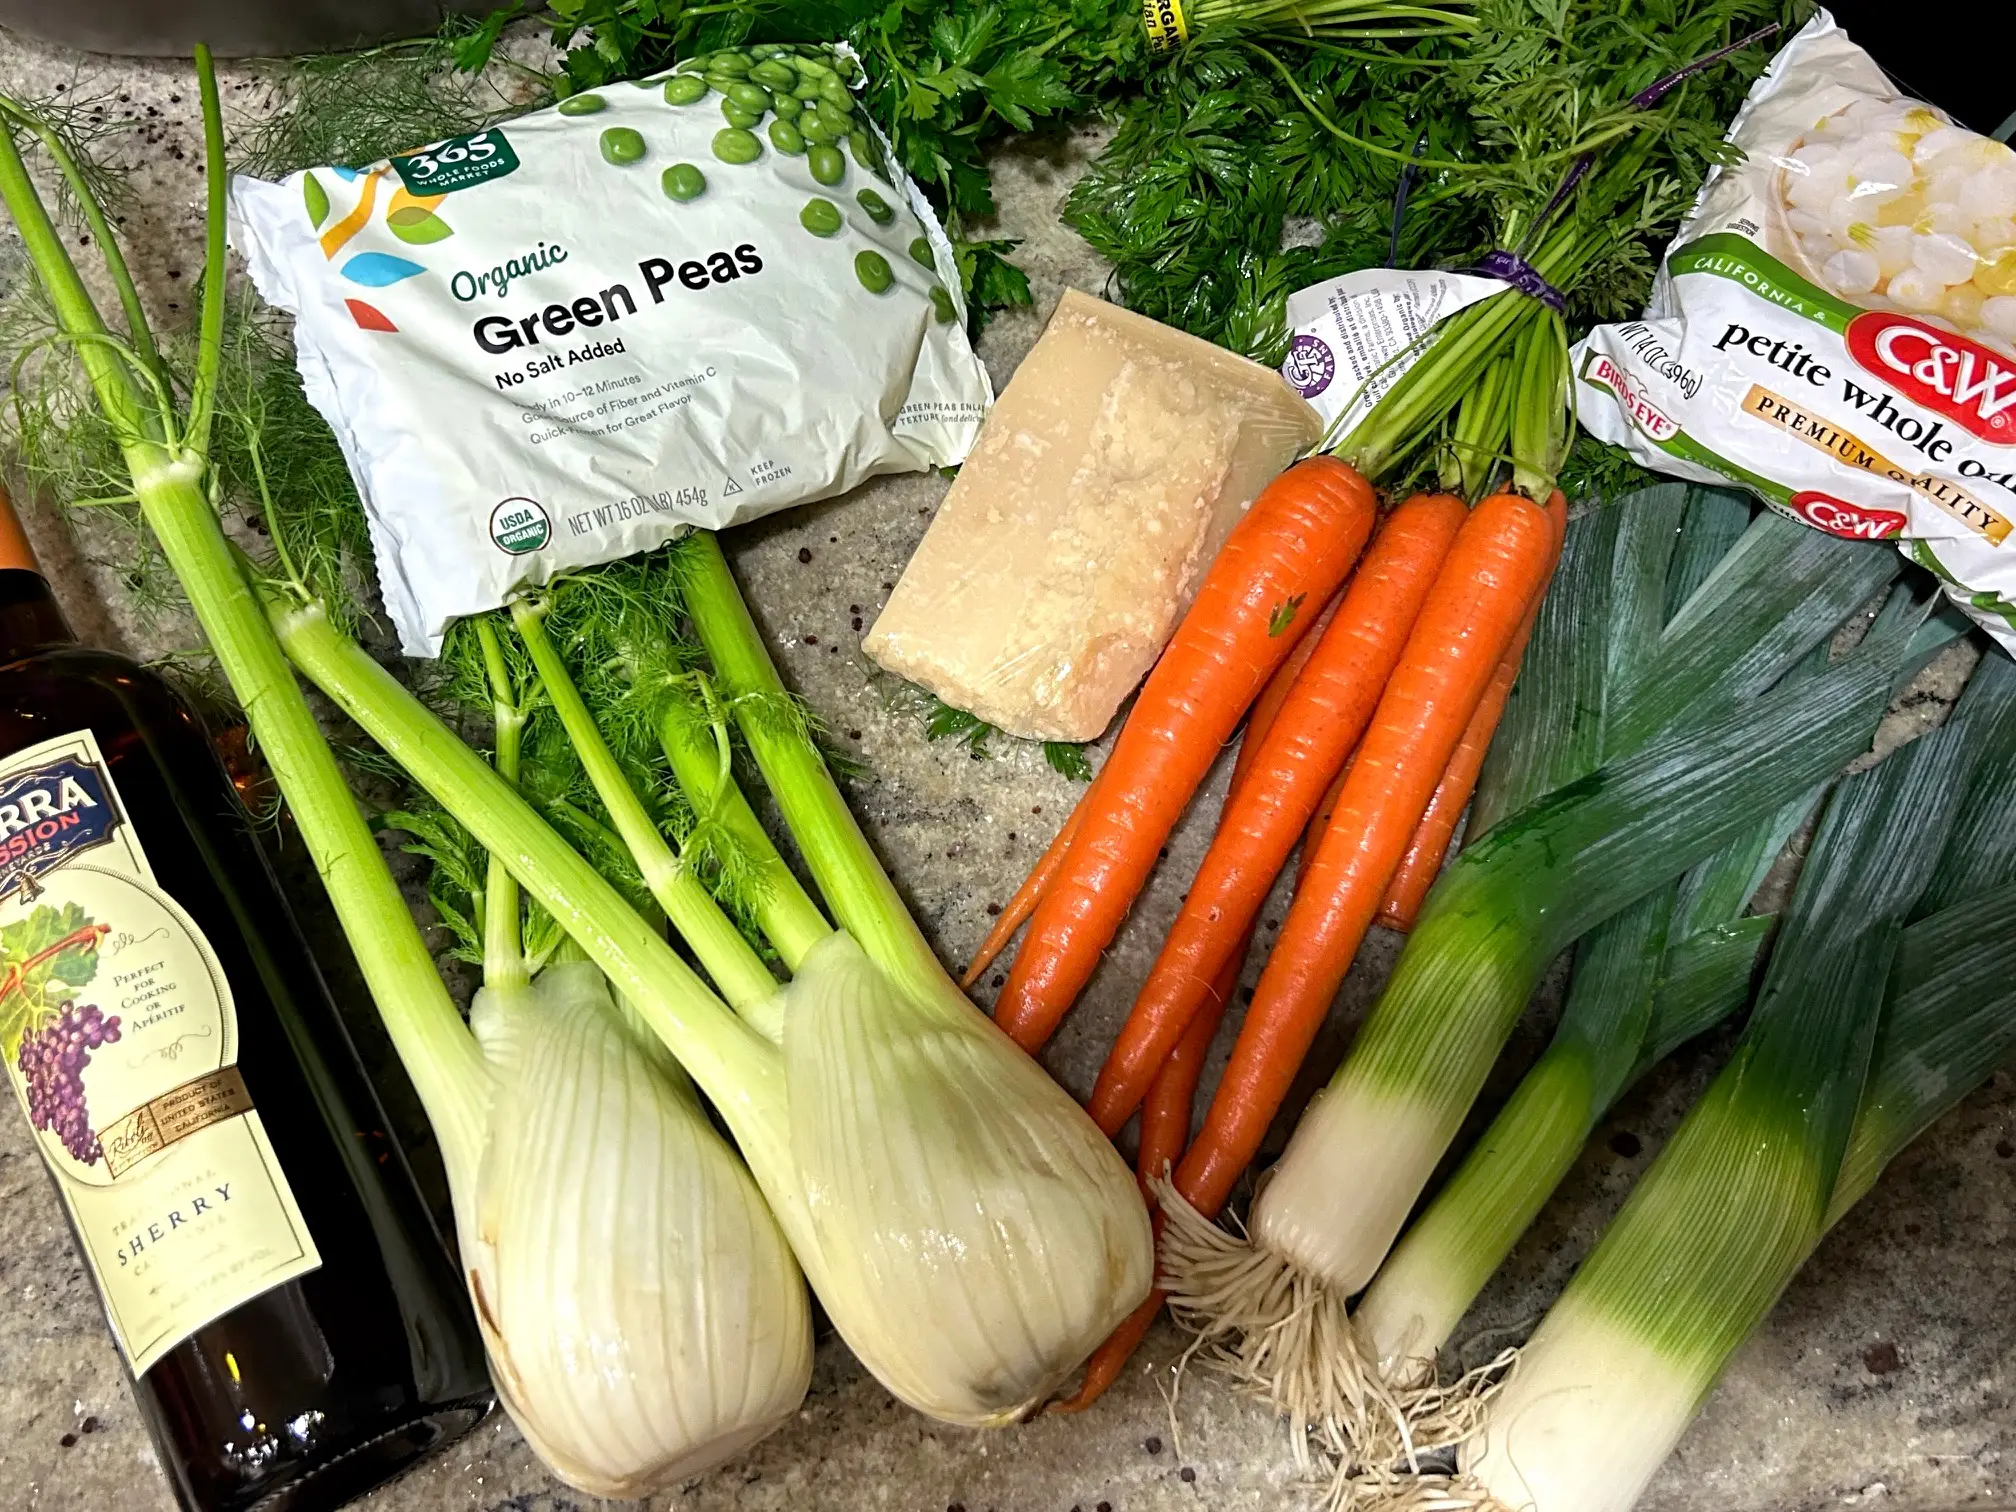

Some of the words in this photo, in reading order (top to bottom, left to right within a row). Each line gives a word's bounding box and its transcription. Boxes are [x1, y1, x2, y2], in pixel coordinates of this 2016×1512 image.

[408, 133, 496, 178] 365
[417, 168, 460, 186] WHOLE
[464, 158, 505, 172] FOODS
[440, 170, 490, 187] MARKET
[451, 241, 569, 302] Organic
[1694, 257, 1803, 313] CALIFORNIA
[1813, 311, 1828, 322] &
[473, 284, 638, 354] Green
[638, 243, 764, 305] Peas
[495, 371, 524, 391] No
[526, 353, 565, 379] Salt
[568, 337, 627, 366] Added
[1311, 339, 1334, 380] FARMS
[1343, 340, 1355, 355] and
[1348, 355, 1365, 381] packed
[1596, 359, 1636, 409] BIRDS
[1875, 326, 2016, 420] C&W
[549, 398, 561, 409] in
[595, 374, 642, 393] Minutes
[597, 403, 608, 415] of
[609, 395, 639, 412] Fiber
[641, 388, 662, 402] and
[662, 373, 706, 393] Vitamin
[703, 366, 717, 378] C
[899, 402, 931, 415] GREEN
[933, 402, 957, 412] PEAS
[1712, 323, 1832, 387] petite
[1842, 378, 1953, 463] whole
[606, 421, 623, 434] for
[624, 409, 657, 427] Great
[659, 393, 692, 414] Flavor
[1756, 396, 1876, 470] PREMIUM
[750, 460, 774, 475] KEEP
[755, 466, 792, 486] FROZEN
[499, 509, 534, 531] USDA
[568, 514, 593, 537] NET
[595, 506, 614, 529] WT
[618, 502, 632, 522] 16
[632, 498, 649, 517] OZ
[675, 486, 708, 507] 454g
[1805, 501, 1890, 539] C&W
[502, 523, 545, 546] ORGANIC
[113, 961, 165, 987] PERFECT
[133, 977, 155, 992] FOR
[121, 982, 177, 1010] COOKING
[145, 1001, 162, 1013] OR
[160, 1104, 196, 1126] UNITED
[199, 1088, 236, 1108] STATES
[162, 1085, 207, 1110] PRODUCT
[209, 1079, 224, 1089] OF
[175, 1104, 232, 1133] CALIFORNIA
[117, 1183, 233, 1267] SHERRY
